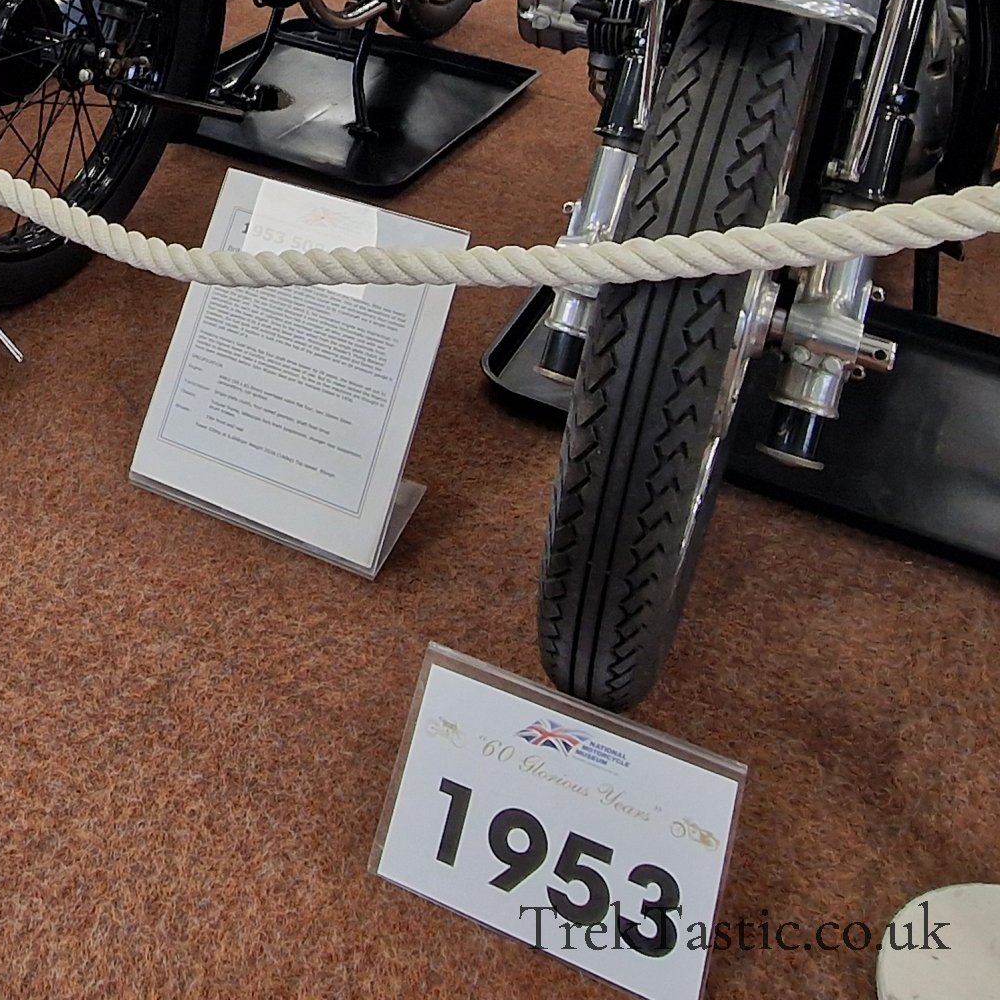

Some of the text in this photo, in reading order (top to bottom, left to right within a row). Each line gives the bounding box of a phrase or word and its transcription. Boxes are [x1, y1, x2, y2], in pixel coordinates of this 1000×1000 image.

[575, 749, 608, 766] MUSEUM
[582, 745, 631, 768] MOTORCYCLE
[589, 741, 627, 761] NATIONAL
[518, 755, 589, 797] Glorious
[436, 776, 682, 959] 1953
